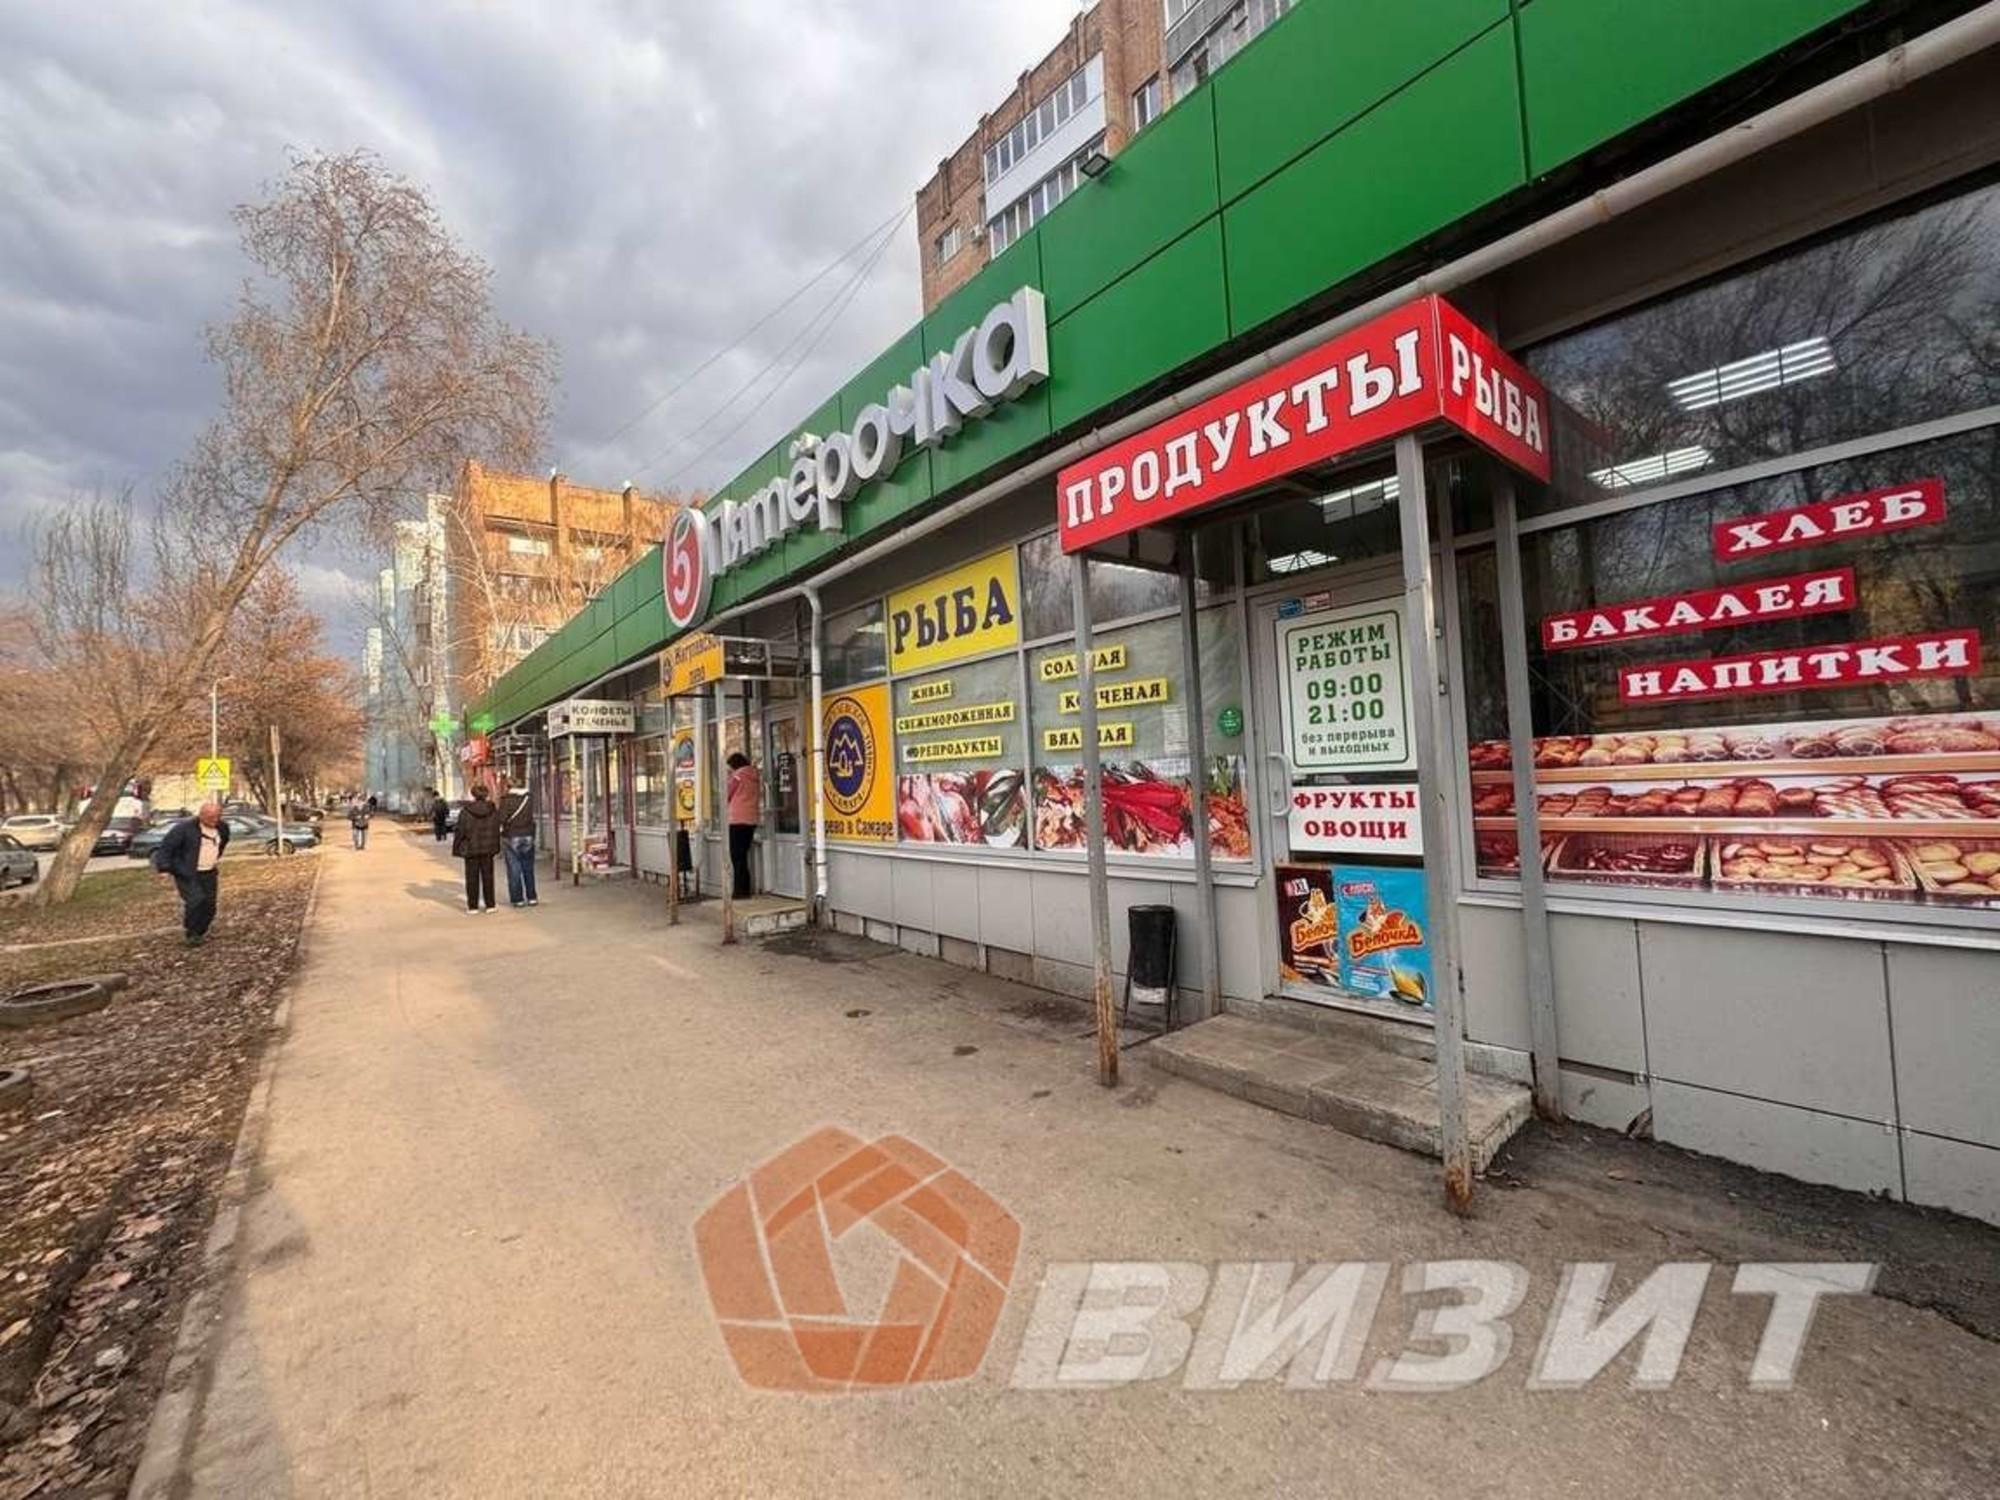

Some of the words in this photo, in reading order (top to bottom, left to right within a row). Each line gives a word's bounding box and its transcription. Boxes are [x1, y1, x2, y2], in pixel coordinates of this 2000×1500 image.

[1450, 333, 1542, 454] РЫБА
[709, 286, 1048, 577] Пятёрочка
[1065, 329, 1422, 529] ПРОДУКТЫ
[1728, 491, 1926, 552] ХЛЕБ
[892, 576, 1013, 655] РЫБА
[1550, 576, 1844, 643] БАКАЛЕЯ
[1298, 624, 1385, 653] РЕЖИМ
[1044, 650, 1120, 676] СОЛАЯ
[1296, 643, 1391, 672] РАБОТЫ
[1627, 638, 1968, 697] НАПИТКИ
[912, 684, 949, 700] ЖИВАЯ
[1066, 683, 1160, 708] КЧЕНАЯ
[1307, 673, 1382, 700] 09:00
[899, 706, 1011, 730] СВЕЖЕМОРОЖЕННАЯ
[1308, 699, 1384, 724] 21:00
[906, 739, 998, 758] ОРЕПРОДУКТЫ
[1050, 727, 1126, 746] ВЯЛАЯ
[1301, 733, 1325, 745] без
[1327, 728, 1395, 743] перерыва
[1309, 746, 1316, 755] и
[1320, 741, 1390, 755] выходных
[1293, 790, 1415, 808] ФРУКТЫ
[1305, 820, 1407, 841] ОВОЩИ
